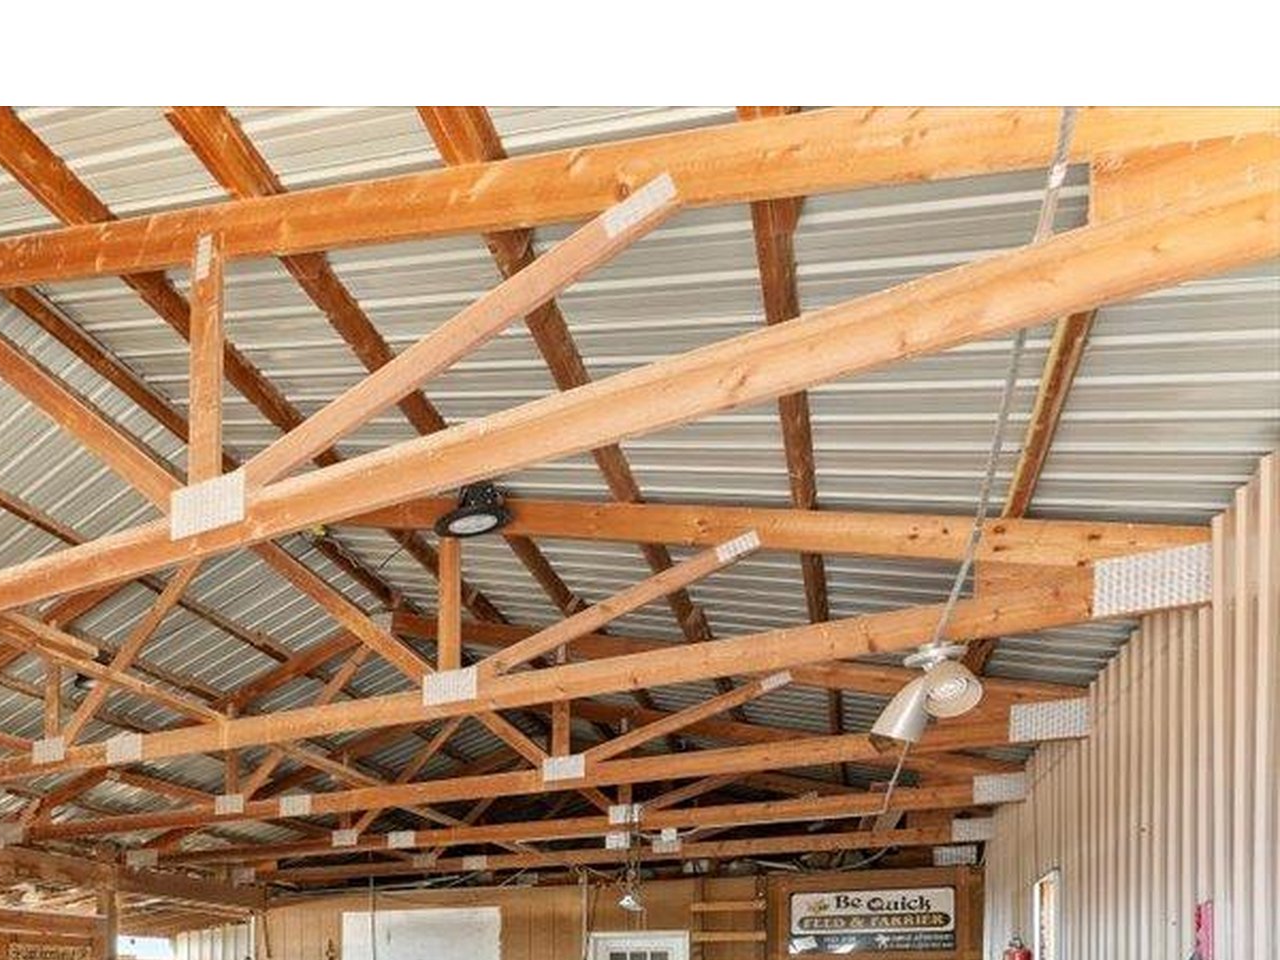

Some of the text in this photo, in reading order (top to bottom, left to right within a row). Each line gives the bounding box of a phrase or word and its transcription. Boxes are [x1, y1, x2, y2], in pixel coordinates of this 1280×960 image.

[835, 894, 932, 912] Be Quick
[802, 914, 945, 929] FEED & FARRIER
